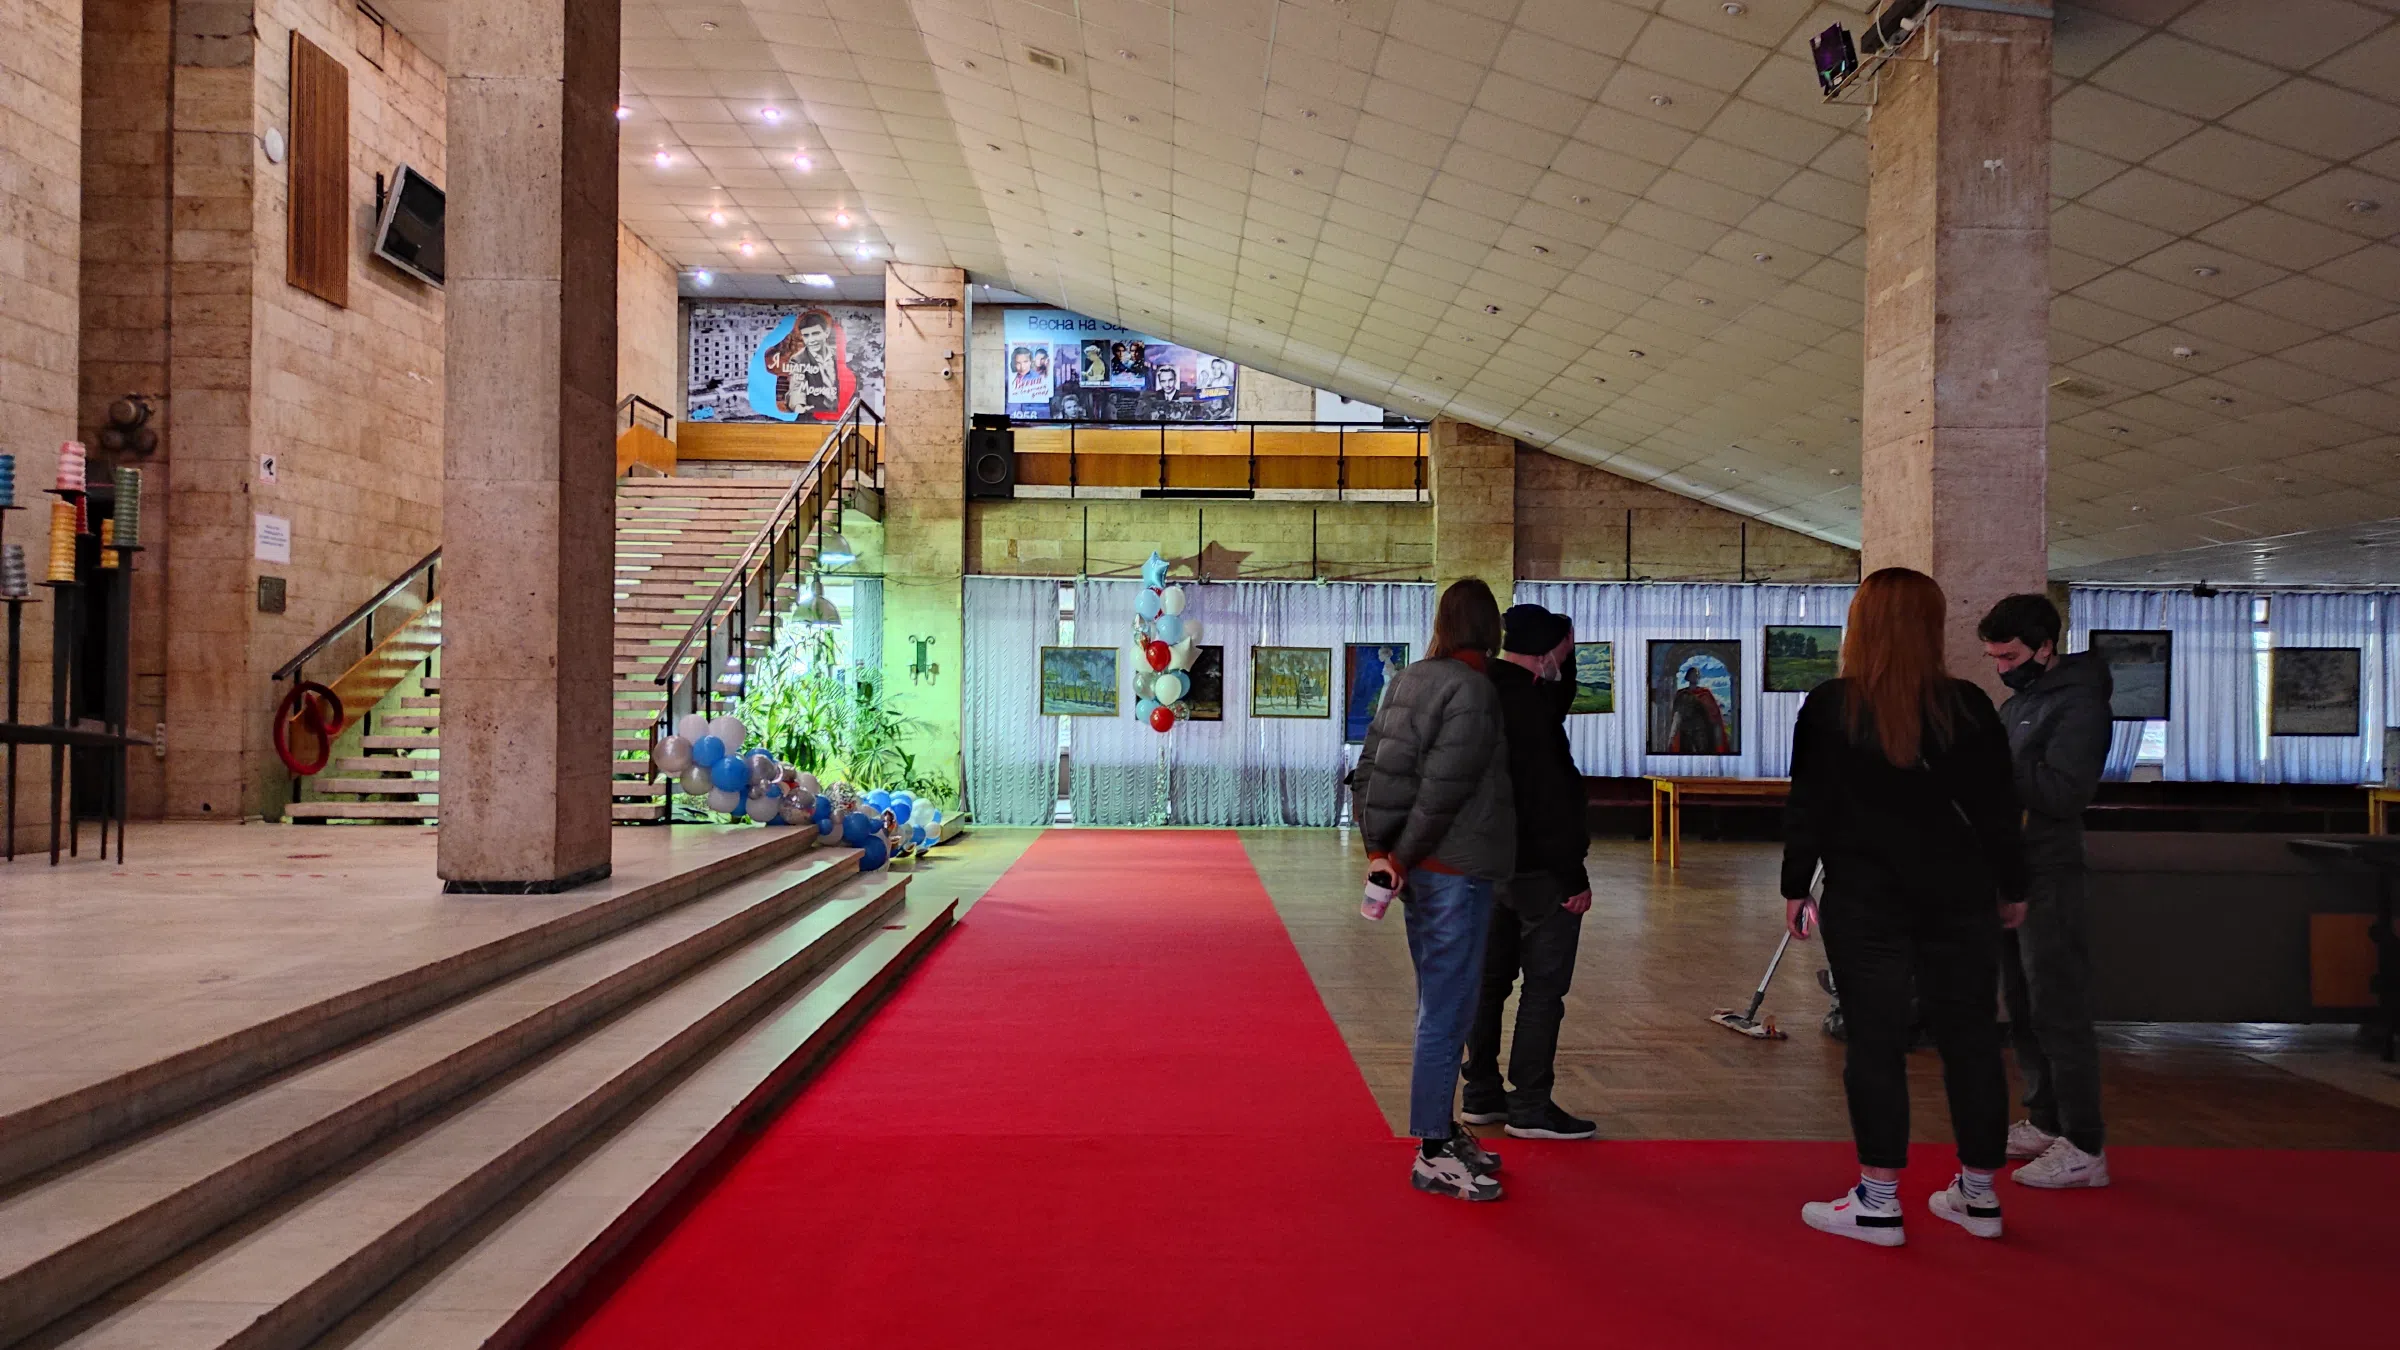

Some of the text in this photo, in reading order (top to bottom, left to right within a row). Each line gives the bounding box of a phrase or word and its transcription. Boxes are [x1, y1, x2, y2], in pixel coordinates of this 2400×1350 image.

[1028, 316, 1074, 330] Весна
[1078, 319, 1096, 330] на
[768, 352, 780, 369] Я
